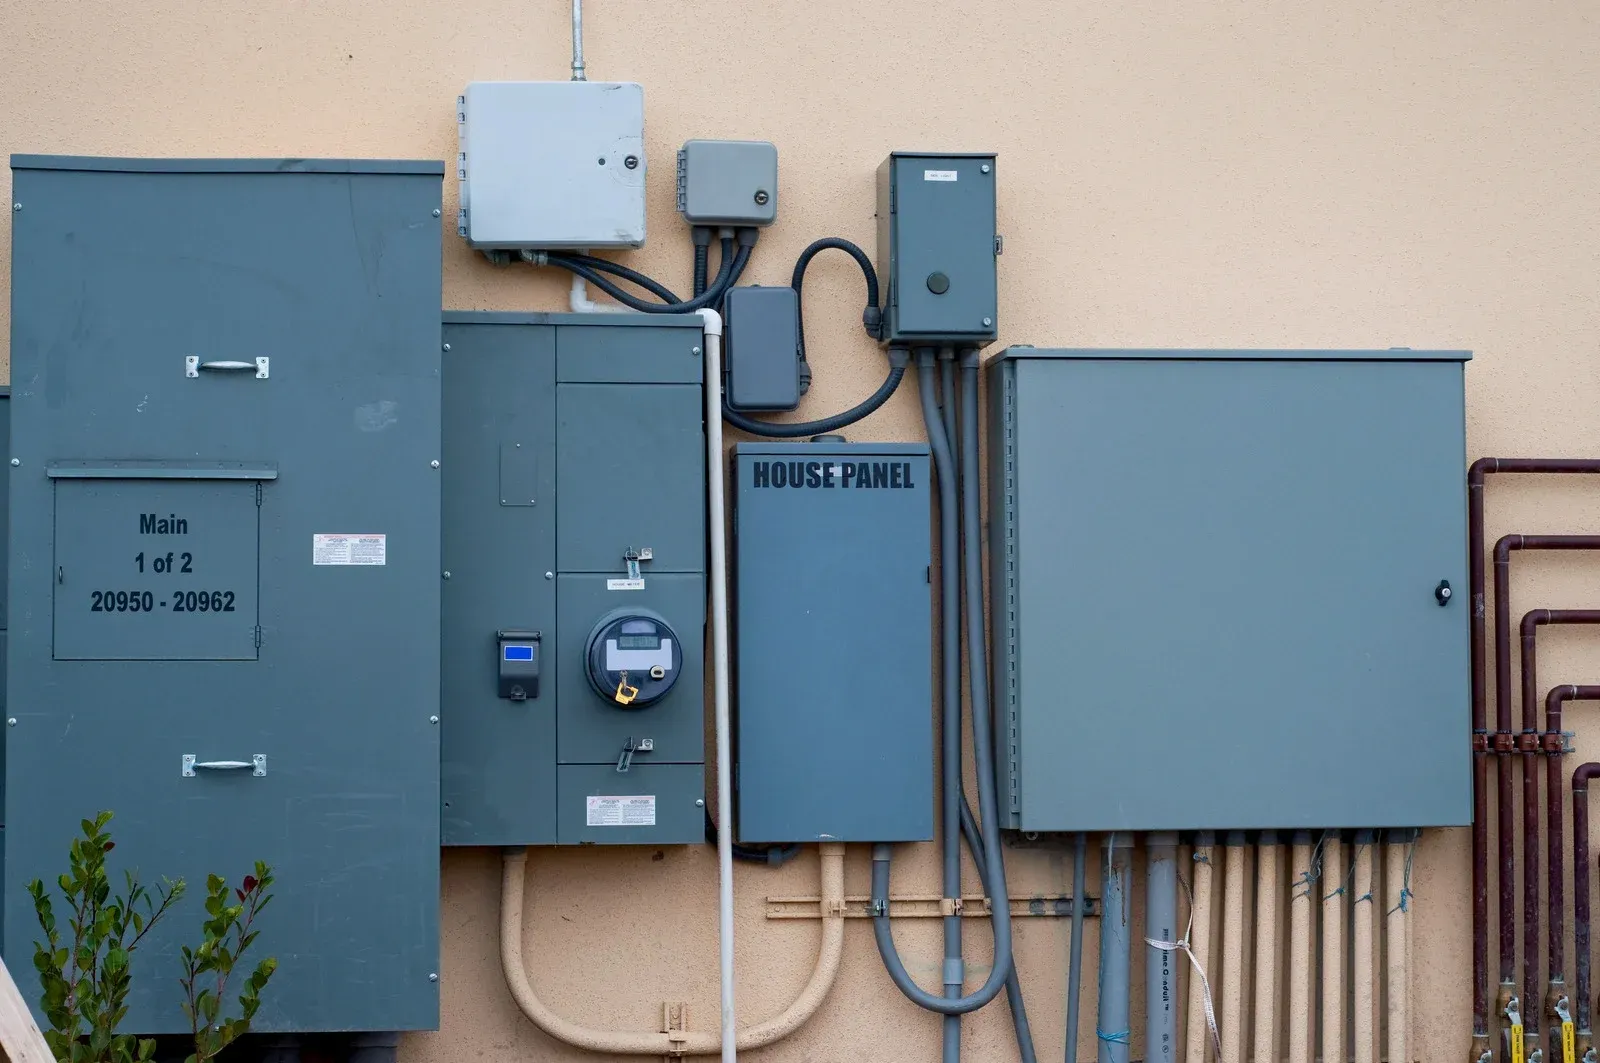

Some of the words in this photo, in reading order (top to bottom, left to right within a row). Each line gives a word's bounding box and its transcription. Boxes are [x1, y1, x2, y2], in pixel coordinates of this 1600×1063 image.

[753, 461, 835, 489] HOUSE
[841, 461, 915, 489] PANEL
[139, 513, 188, 535] Main
[135, 552, 144, 573] 1
[153, 552, 174, 573] of
[180, 552, 193, 573] 2
[90, 590, 154, 613] 20950
[172, 590, 236, 613] 20962
